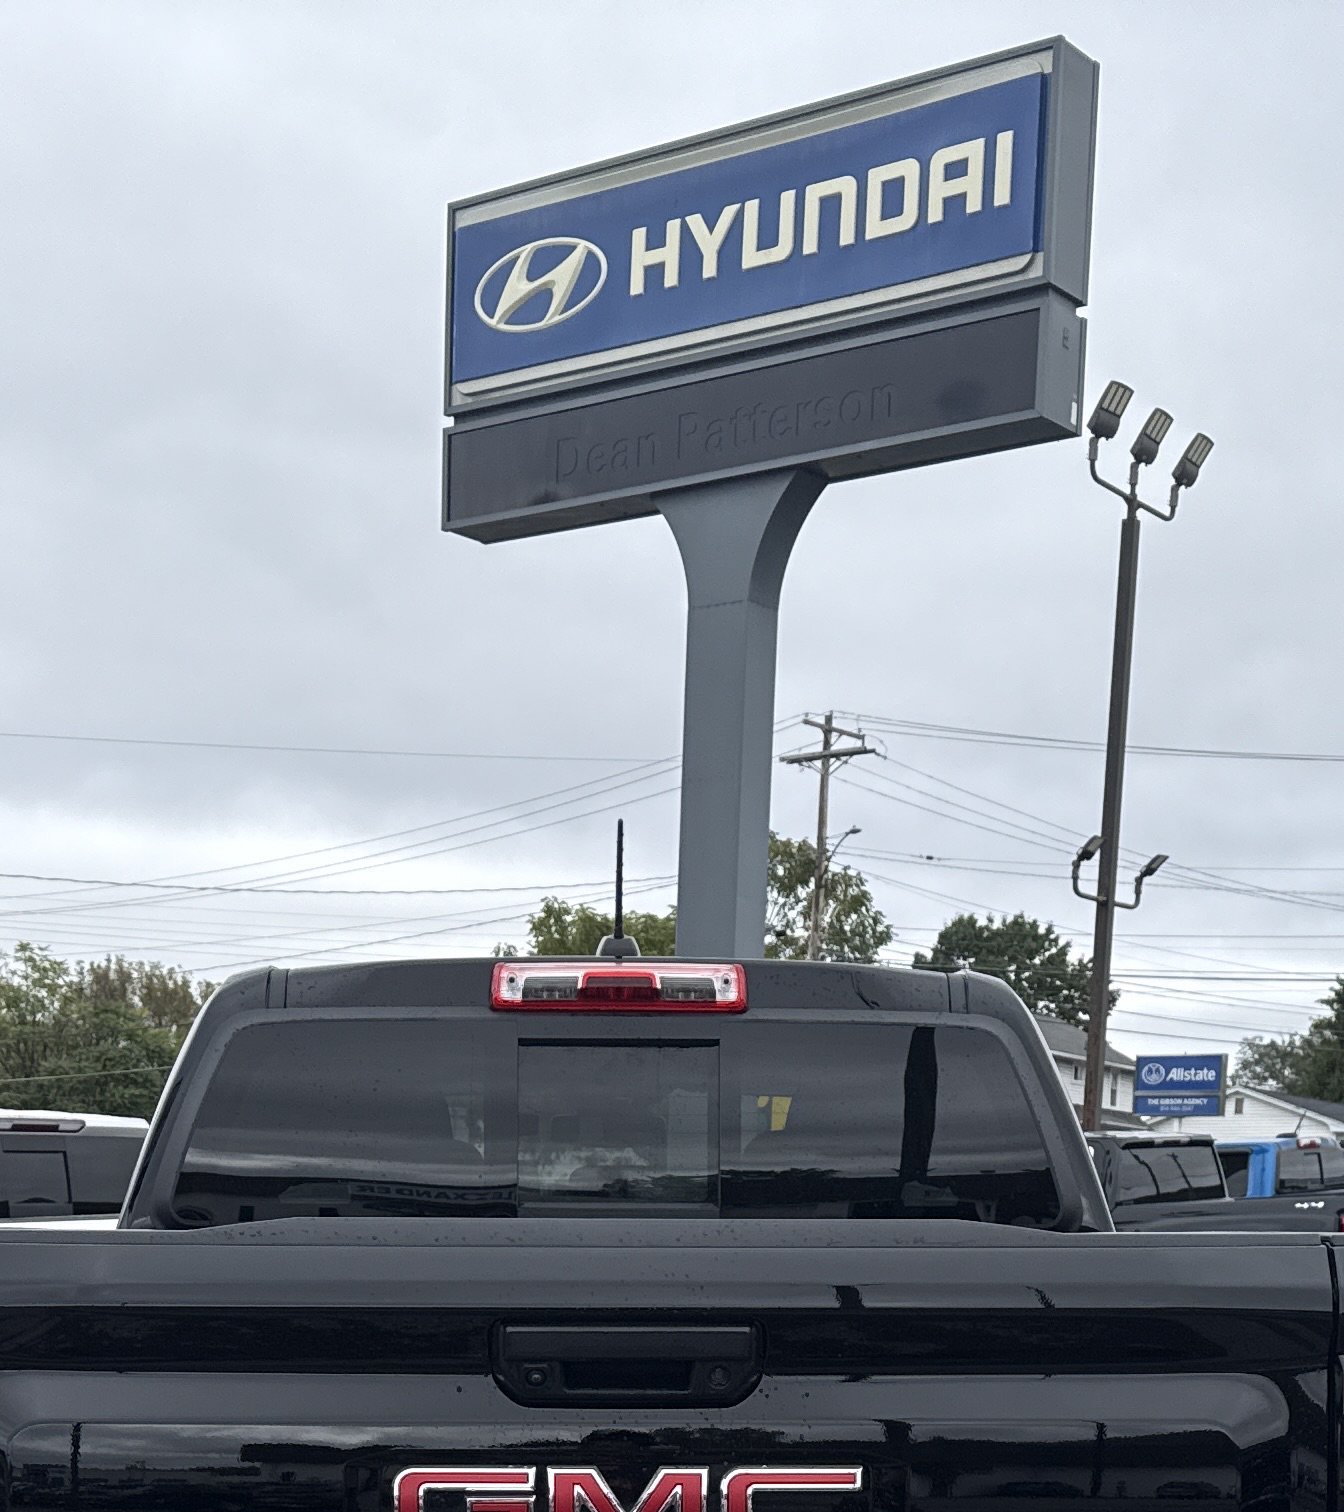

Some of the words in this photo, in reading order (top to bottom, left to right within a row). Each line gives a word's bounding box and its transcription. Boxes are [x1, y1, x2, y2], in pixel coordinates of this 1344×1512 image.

[629, 130, 1014, 296] HYUNDAI
[555, 432, 656, 484] Dean
[677, 383, 897, 460] Patterson
[1166, 1066, 1217, 1082] Allstate
